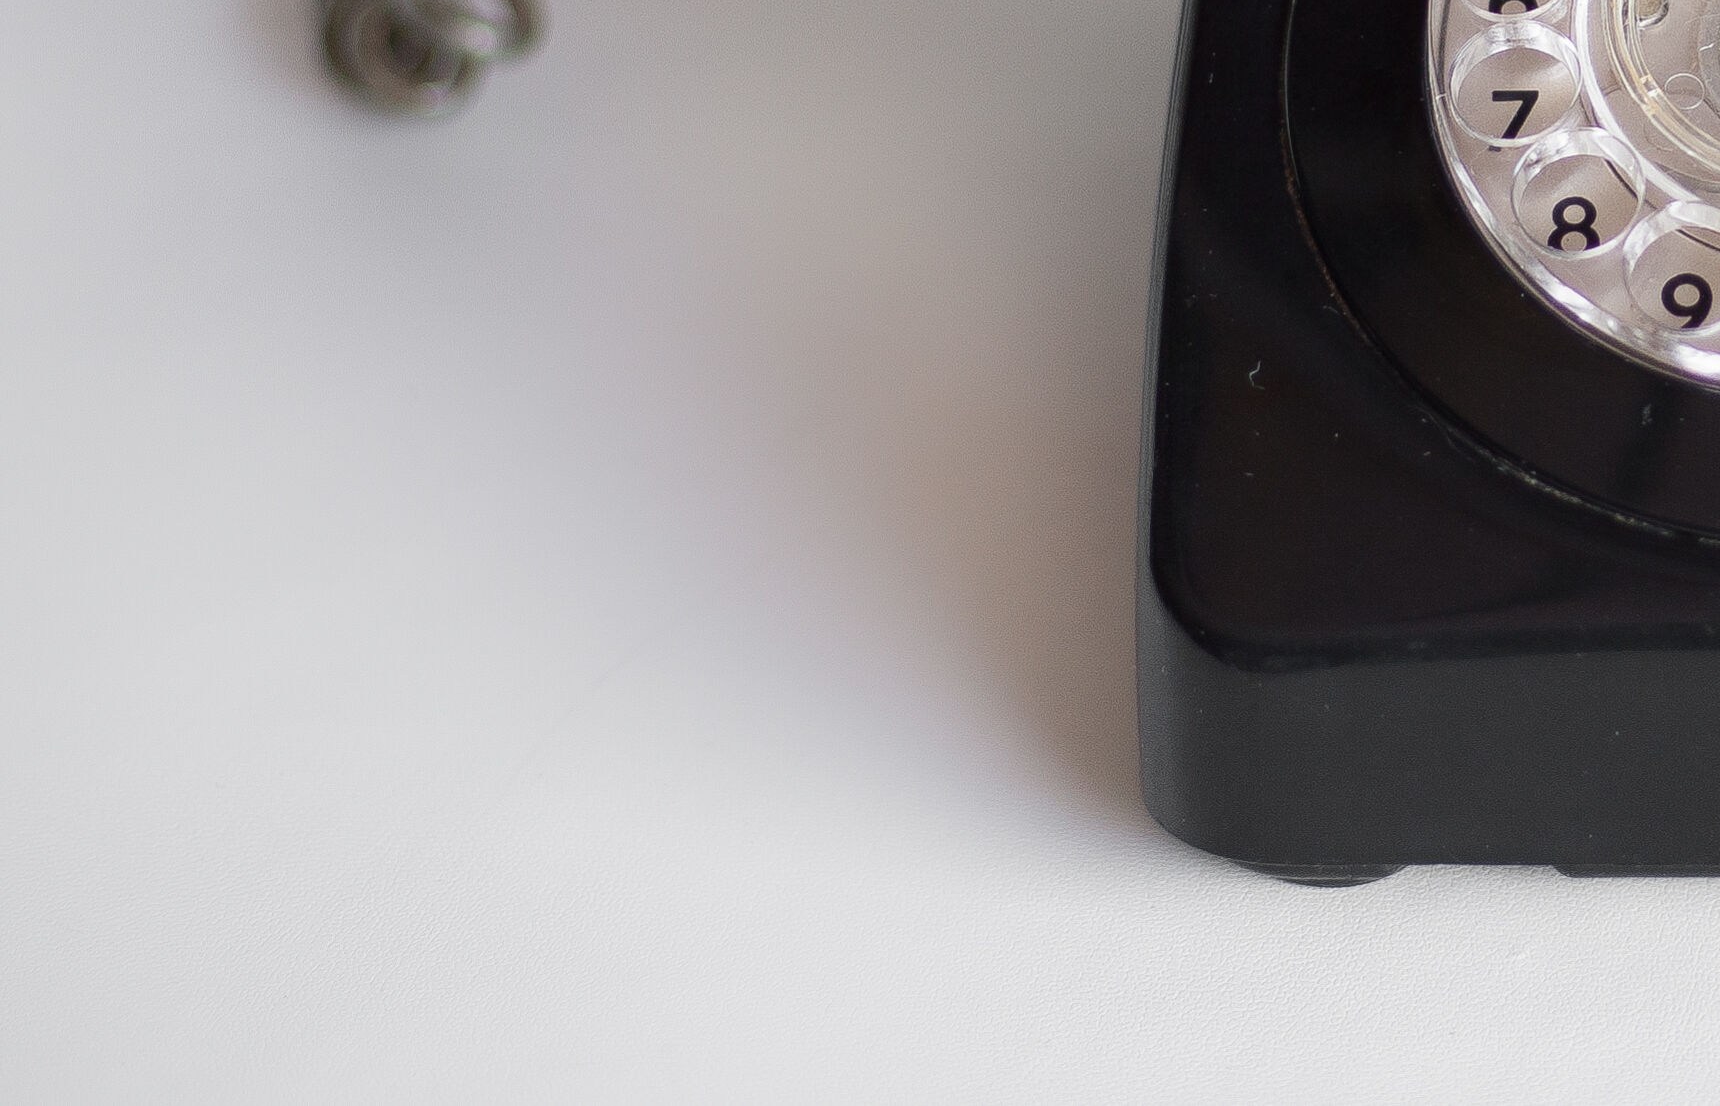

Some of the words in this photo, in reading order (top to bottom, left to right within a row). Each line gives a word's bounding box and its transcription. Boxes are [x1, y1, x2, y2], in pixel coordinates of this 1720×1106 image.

[1490, 90, 1539, 148] 7
[1547, 196, 1601, 251] 8
[1661, 272, 1713, 329] 9
